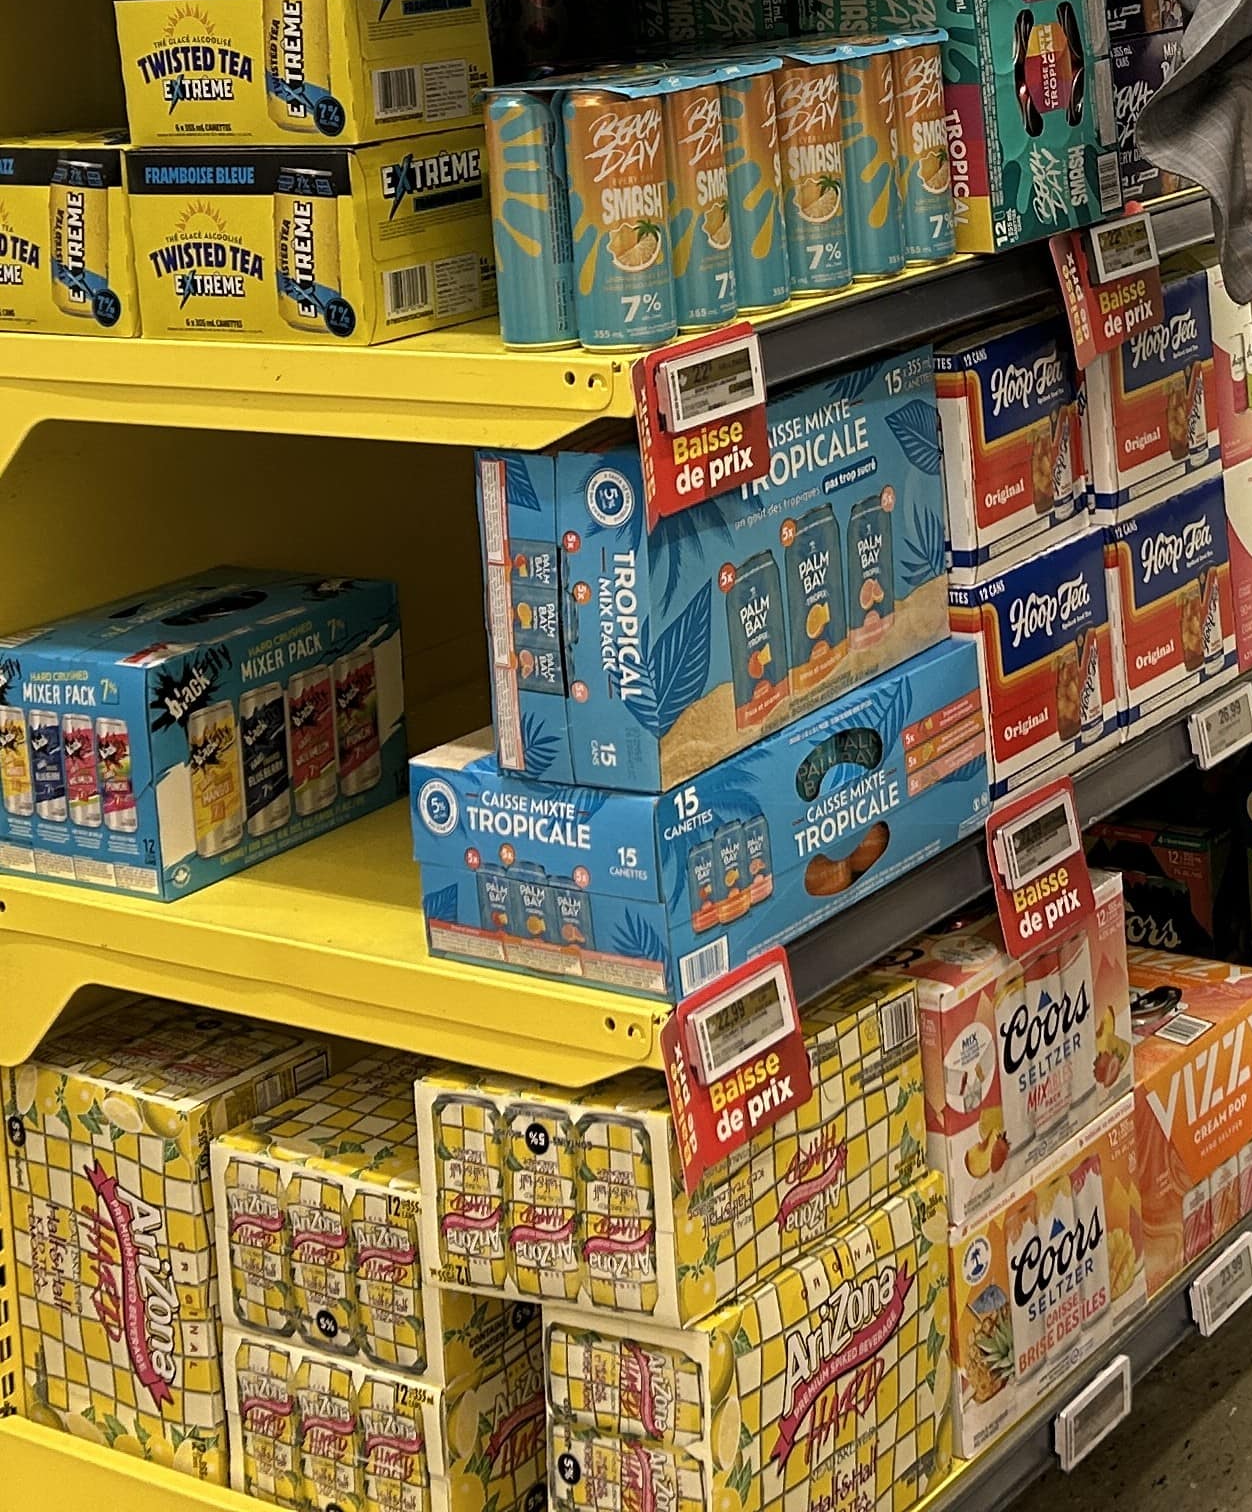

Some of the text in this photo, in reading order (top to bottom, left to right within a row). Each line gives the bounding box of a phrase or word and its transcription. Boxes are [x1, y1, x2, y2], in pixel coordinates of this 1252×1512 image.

[137, 46, 253, 84] TWISTED TEA
[589, 108, 662, 149] BEACH
[145, 165, 255, 185] FRAMBOISE BLEUE
[584, 138, 661, 183] DAY
[788, 141, 842, 181] SMASH
[944, 109, 971, 227] TROPICAL
[381, 148, 482, 221] EXTRÊME
[602, 182, 664, 224] SMASH
[149, 243, 264, 280] TWISTED TEA
[806, 241, 842, 270] 7%
[621, 293, 662, 323] 7%
[1098, 279, 1146, 315] Baisse
[1103, 299, 1153, 338] de prix
[962, 347, 987, 367] 12 CANS
[885, 367, 902, 396] 15
[991, 351, 1064, 417] Hoop Tea
[804, 397, 851, 432] MIXTE
[673, 421, 743, 466] Baisse
[1124, 427, 1161, 454] Original
[675, 446, 754, 496] de prix
[824, 458, 877, 494] pas trop sucré
[984, 478, 1025, 509] Original
[798, 548, 830, 581] PALM
[1141, 514, 1213, 584] Hoop Tea
[803, 569, 828, 594] BAY
[598, 578, 615, 672] MIX PACK
[611, 549, 643, 701] TROPICAL
[739, 591, 771, 624] PALM
[743, 613, 771, 640] BAY
[1009, 571, 1091, 648] Hoop Tea
[240, 630, 323, 683] MIXER PACK
[1134, 640, 1175, 670] Original
[22, 681, 96, 706] MIXER PACK
[30, 671, 51, 682] HARD
[164, 667, 211, 723] black
[1002, 707, 1049, 743] Original
[599, 743, 617, 768] 15
[481, 789, 575, 821] CAISSE MIXTE
[673, 786, 700, 818] 15
[804, 766, 886, 825] CAISSE MIXTE
[466, 806, 591, 851] TROPICALE
[662, 807, 715, 842] CANETTES
[793, 781, 900, 858] TROPICALE
[609, 863, 648, 882] CANETTES
[616, 846, 638, 868] 15
[1012, 866, 1070, 913] Baisse
[1018, 887, 1081, 940] de prix
[1000, 980, 1090, 1076] Coors
[709, 1052, 780, 1113] Baisse
[1018, 1032, 1082, 1093] SELTZER
[717, 1075, 794, 1142] de prix
[1193, 1092, 1249, 1146] CREAM POP
[355, 1226, 411, 1258] AriZona
[1009, 1204, 1104, 1307] Coors
[116, 1184, 179, 1384] AriZona
[1027, 1258, 1094, 1322] SELTZER
[318, 1316, 337, 1333] 5%
[1046, 1293, 1079, 1329] CAISSE
[783, 1265, 898, 1417] AriZona
[1017, 1332, 1055, 1376] BRISE
[1055, 1313, 1081, 1342] DES
[794, 1311, 897, 1417] PREMIUM SPIKED BEVERAGE
